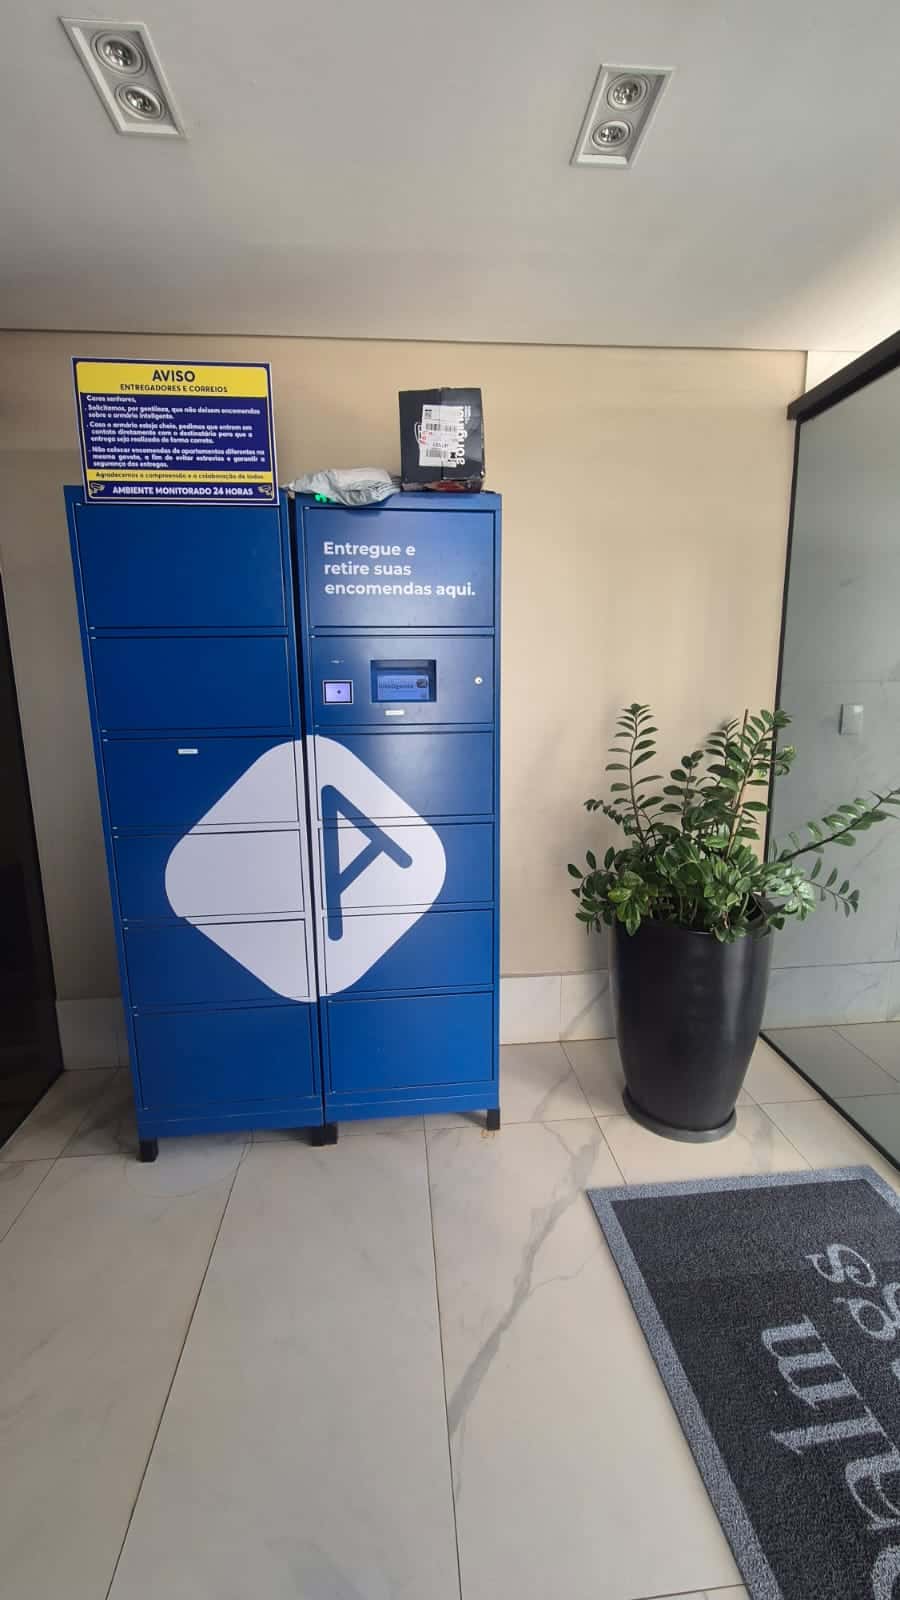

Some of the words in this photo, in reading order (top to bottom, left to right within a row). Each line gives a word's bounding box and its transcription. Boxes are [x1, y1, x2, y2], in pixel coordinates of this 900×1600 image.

[152, 369, 195, 382] AVISO
[156, 486, 211, 494] MONITORADO
[323, 542, 401, 558] Entregue
[406, 544, 416, 556] e
[324, 561, 370, 575] retire
[374, 564, 412, 576] suas
[324, 582, 433, 595] encomendas
[436, 582, 476, 598] aqui.
